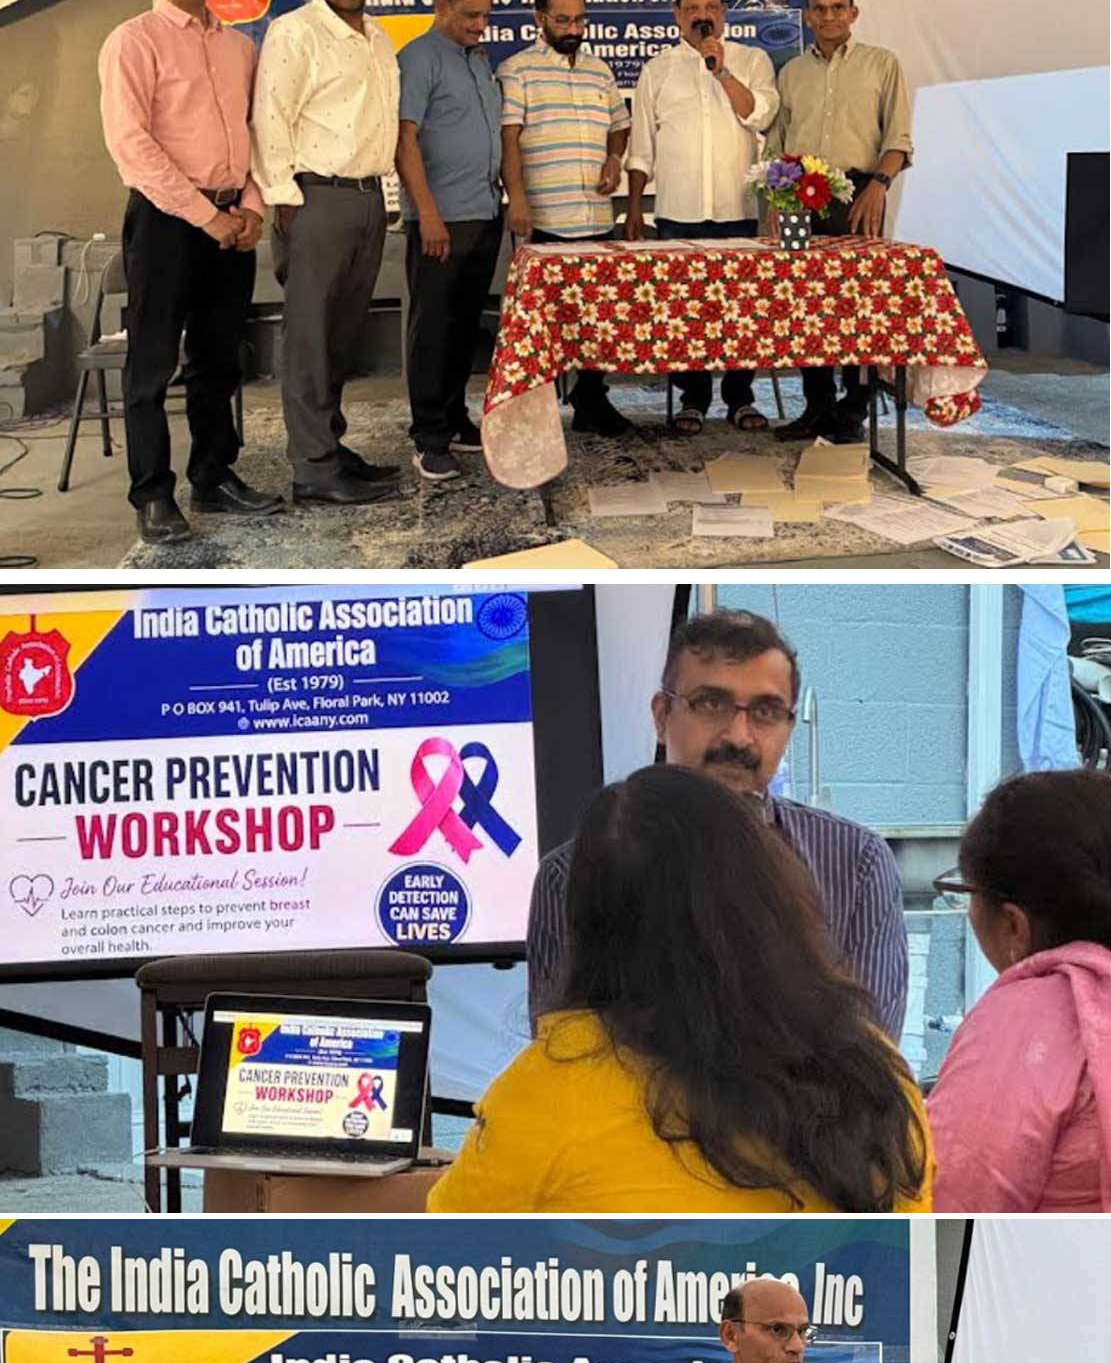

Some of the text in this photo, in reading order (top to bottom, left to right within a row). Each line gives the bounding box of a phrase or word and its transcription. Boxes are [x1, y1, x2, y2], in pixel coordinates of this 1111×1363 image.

[631, 22, 757, 40] Assoion
[133, 596, 474, 639] India Catholic Association
[235, 635, 377, 672] of America
[267, 674, 345, 693] (Est 1979)
[161, 702, 170, 716] P
[173, 702, 185, 716] O
[187, 701, 215, 716] BOX
[248, 697, 280, 714] Tulip
[282, 696, 311, 712] Ave,
[313, 694, 349, 710] Floral
[352, 693, 384, 709] Park,
[387, 692, 407, 707] NY
[409, 691, 451, 706] 11002
[253, 714, 369, 730] www.icaany.com
[15, 748, 381, 807] CANCER PREVENTION
[75, 804, 336, 860] WORKSHOP
[60, 866, 309, 899] Join Our Educational Session!
[404, 874, 445, 889] EARLY
[388, 890, 459, 904] DETECTION
[61, 898, 311, 922] Learn practical steps to prevent breast
[389, 906, 457, 920] CAN SAVE
[61, 917, 295, 938] and colon cancer and improve your
[396, 923, 452, 940] LIVES
[61, 939, 153, 955] overall health.
[239, 1068, 349, 1087] CANCER PREVENTION
[255, 1085, 334, 1104] WORKSHOP
[28, 1244, 101, 1313] The
[111, 1246, 209, 1314] India
[218, 1248, 376, 1318] Catholic
[391, 1253, 605, 1322] Association
[613, 1259, 648, 1323] of
[812, 1261, 864, 1327] Inc
